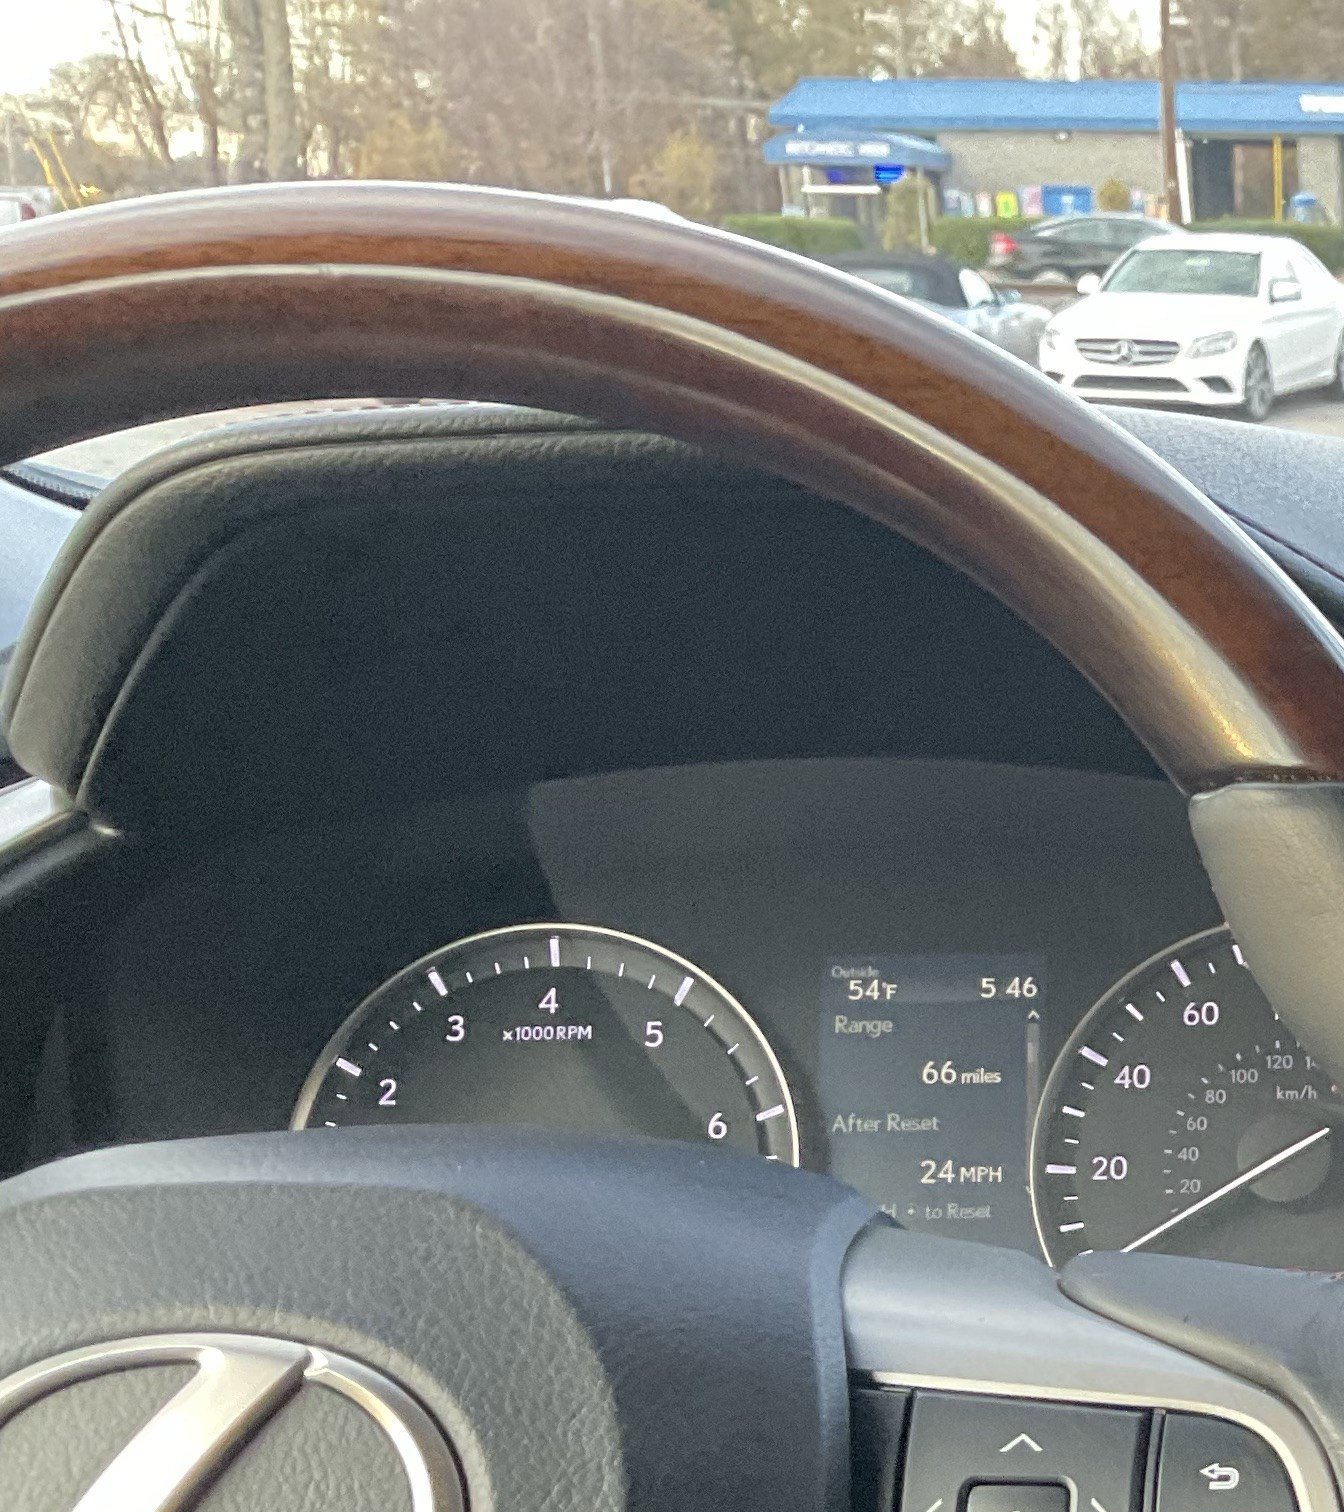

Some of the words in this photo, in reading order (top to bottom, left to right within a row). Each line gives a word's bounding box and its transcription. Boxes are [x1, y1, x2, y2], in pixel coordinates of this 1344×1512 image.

[538, 987, 559, 1014] 4
[1183, 1001, 1220, 1026] 60
[445, 1015, 465, 1042] 3
[644, 1020, 664, 1048] 5
[834, 1014, 894, 1039] Range
[922, 1060, 957, 1085] 66
[960, 1067, 1002, 1085] miles
[1266, 1054, 1294, 1070] 120
[1113, 1064, 1151, 1089] 40
[1228, 1068, 1259, 1084] 100
[378, 1078, 397, 1106] 2
[1204, 1089, 1227, 1104] 80
[1276, 1084, 1317, 1100] km/h
[707, 1112, 728, 1140] 6
[831, 1112, 882, 1133] After
[886, 1112, 939, 1132] Reset
[1186, 1116, 1208, 1131] 60
[1177, 1146, 1199, 1162] 40
[920, 1159, 956, 1184] 24
[959, 1166, 1002, 1183] MPH
[1092, 1155, 1128, 1181] 20
[1179, 1178, 1201, 1195] 20
[947, 1202, 991, 1220] Reset
